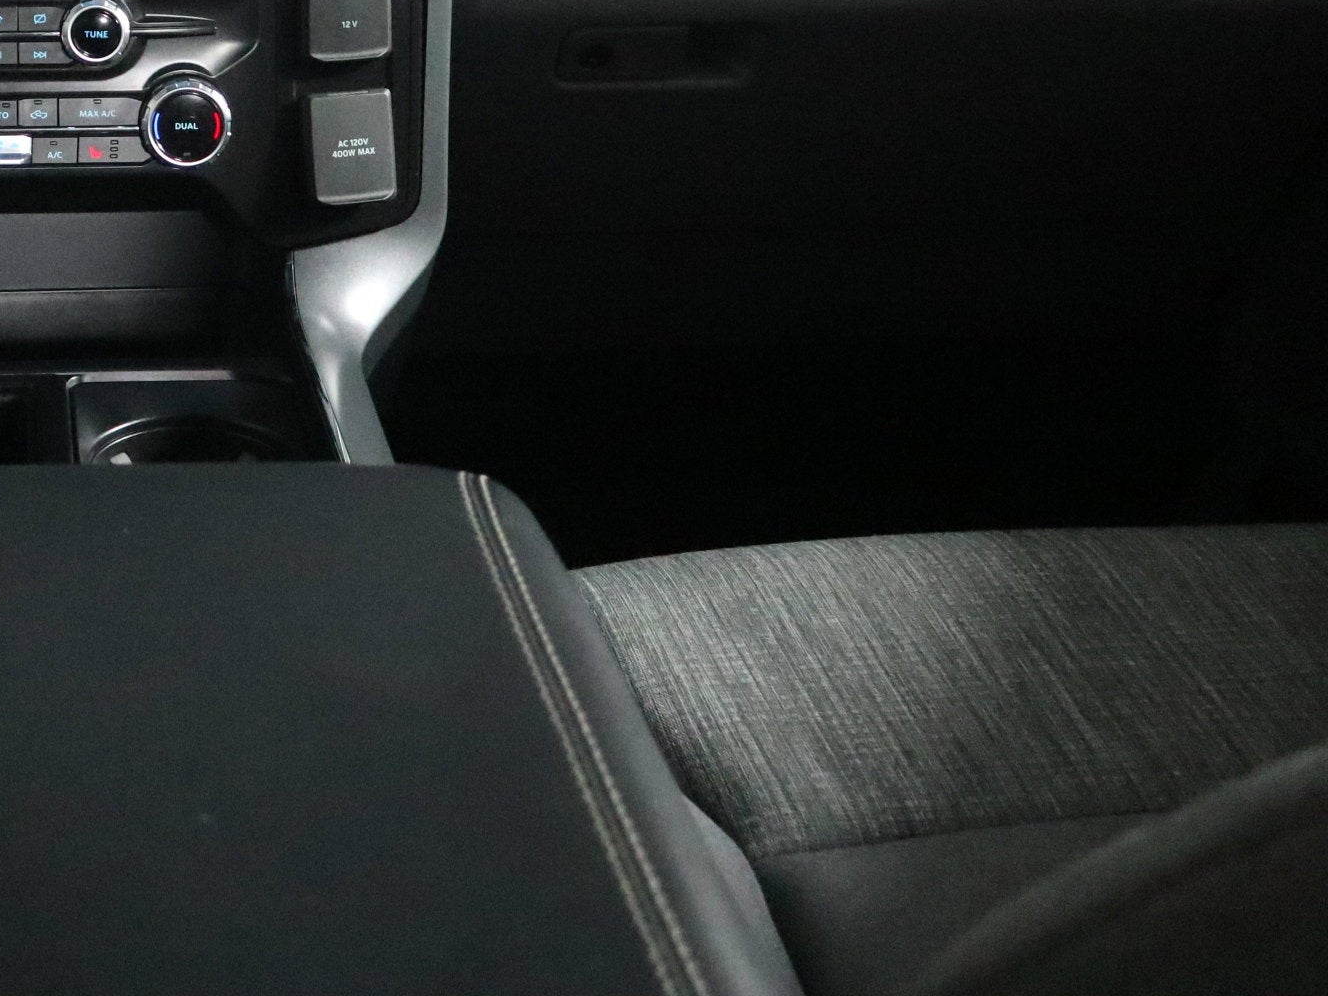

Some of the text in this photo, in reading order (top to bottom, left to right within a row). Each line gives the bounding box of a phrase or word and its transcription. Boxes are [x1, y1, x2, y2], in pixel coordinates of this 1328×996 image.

[352, 20, 358, 28] V
[84, 30, 110, 39] TUNE
[79, 109, 117, 118] MAX A/C
[174, 122, 199, 130] DUAL
[338, 138, 369, 148] AC 120V
[47, 151, 63, 159] A/C
[332, 147, 376, 158] 400W MAX
